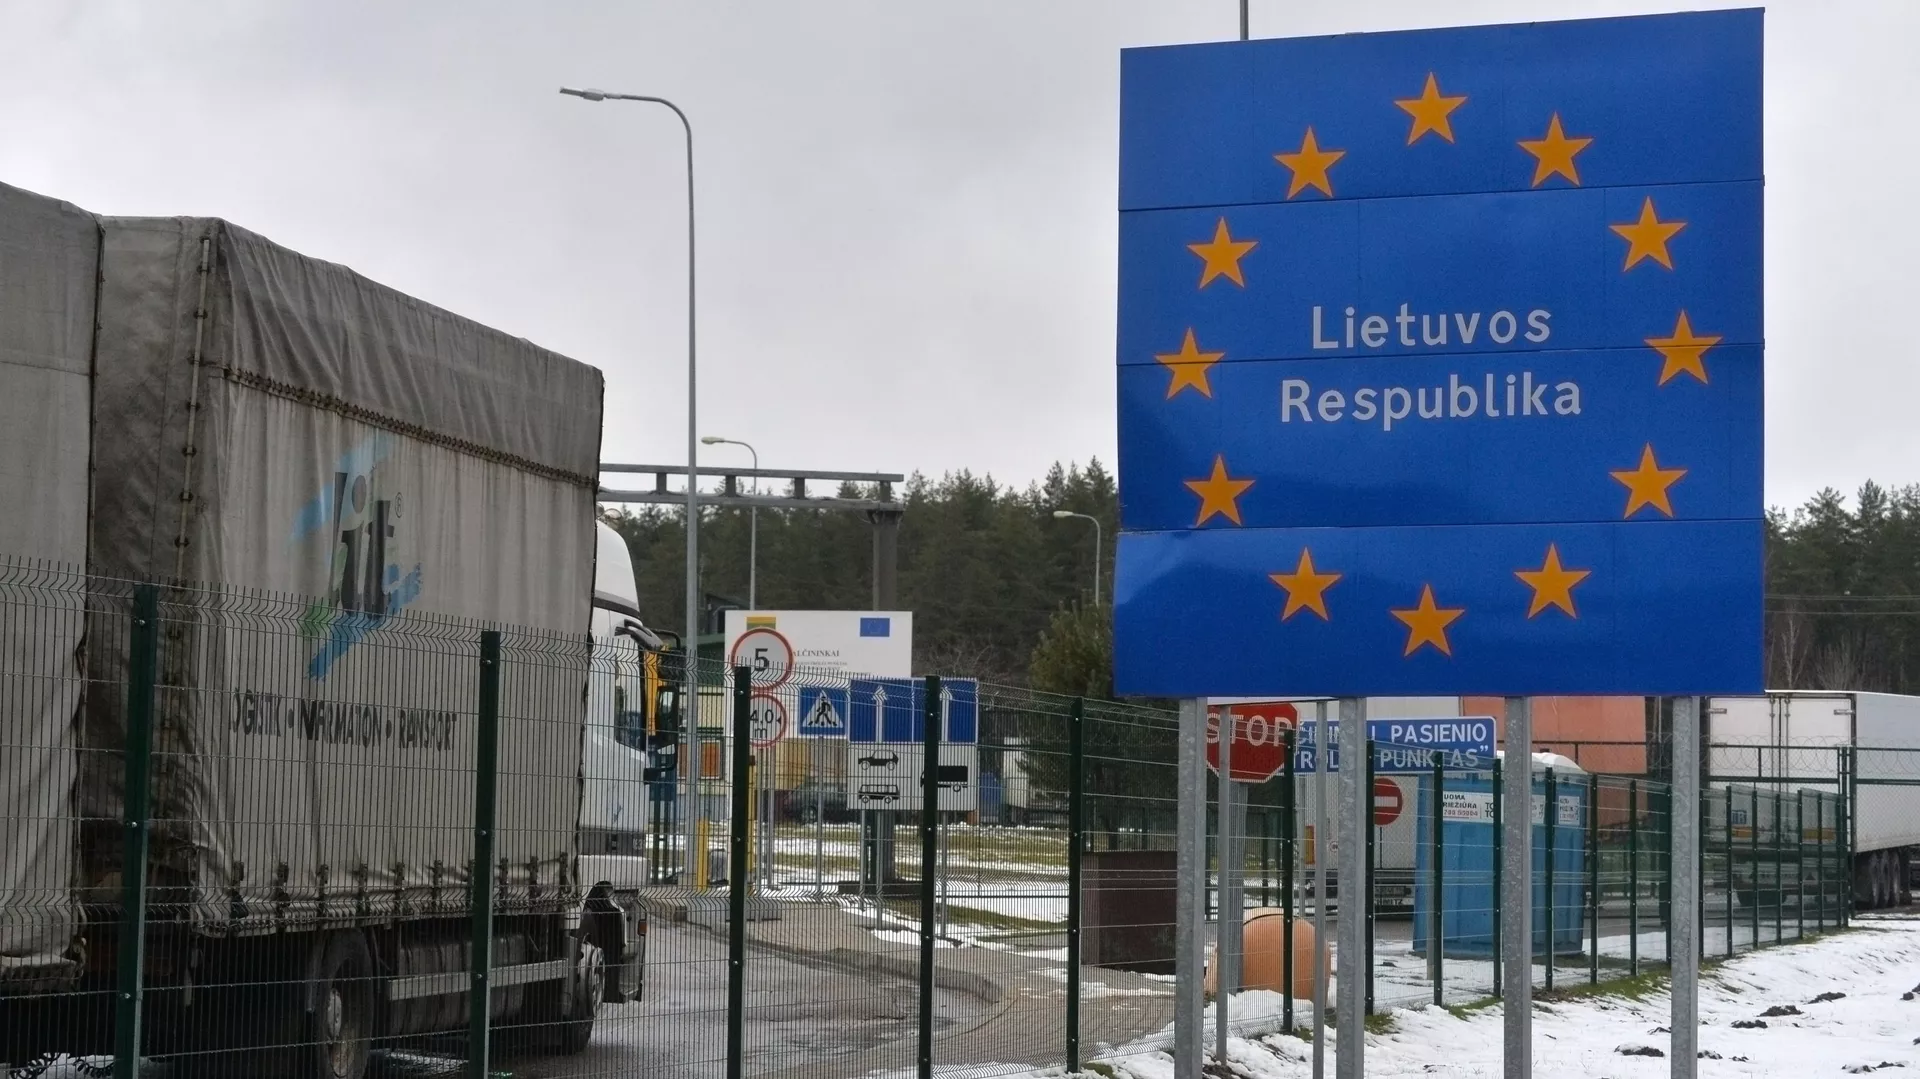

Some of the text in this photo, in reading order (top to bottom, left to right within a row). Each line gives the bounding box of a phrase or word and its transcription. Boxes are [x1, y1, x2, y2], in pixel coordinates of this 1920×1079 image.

[1312, 303, 1551, 349] Lietuvos
[1281, 371, 1582, 431] Respublika
[754, 648, 770, 672] 5
[1206, 712, 1293, 747] STOP
[1391, 723, 1487, 744] PASIENIO
[1380, 744, 1489, 768] PUNKAS”
[1443, 800, 1477, 809] RIEŽIŪRA
